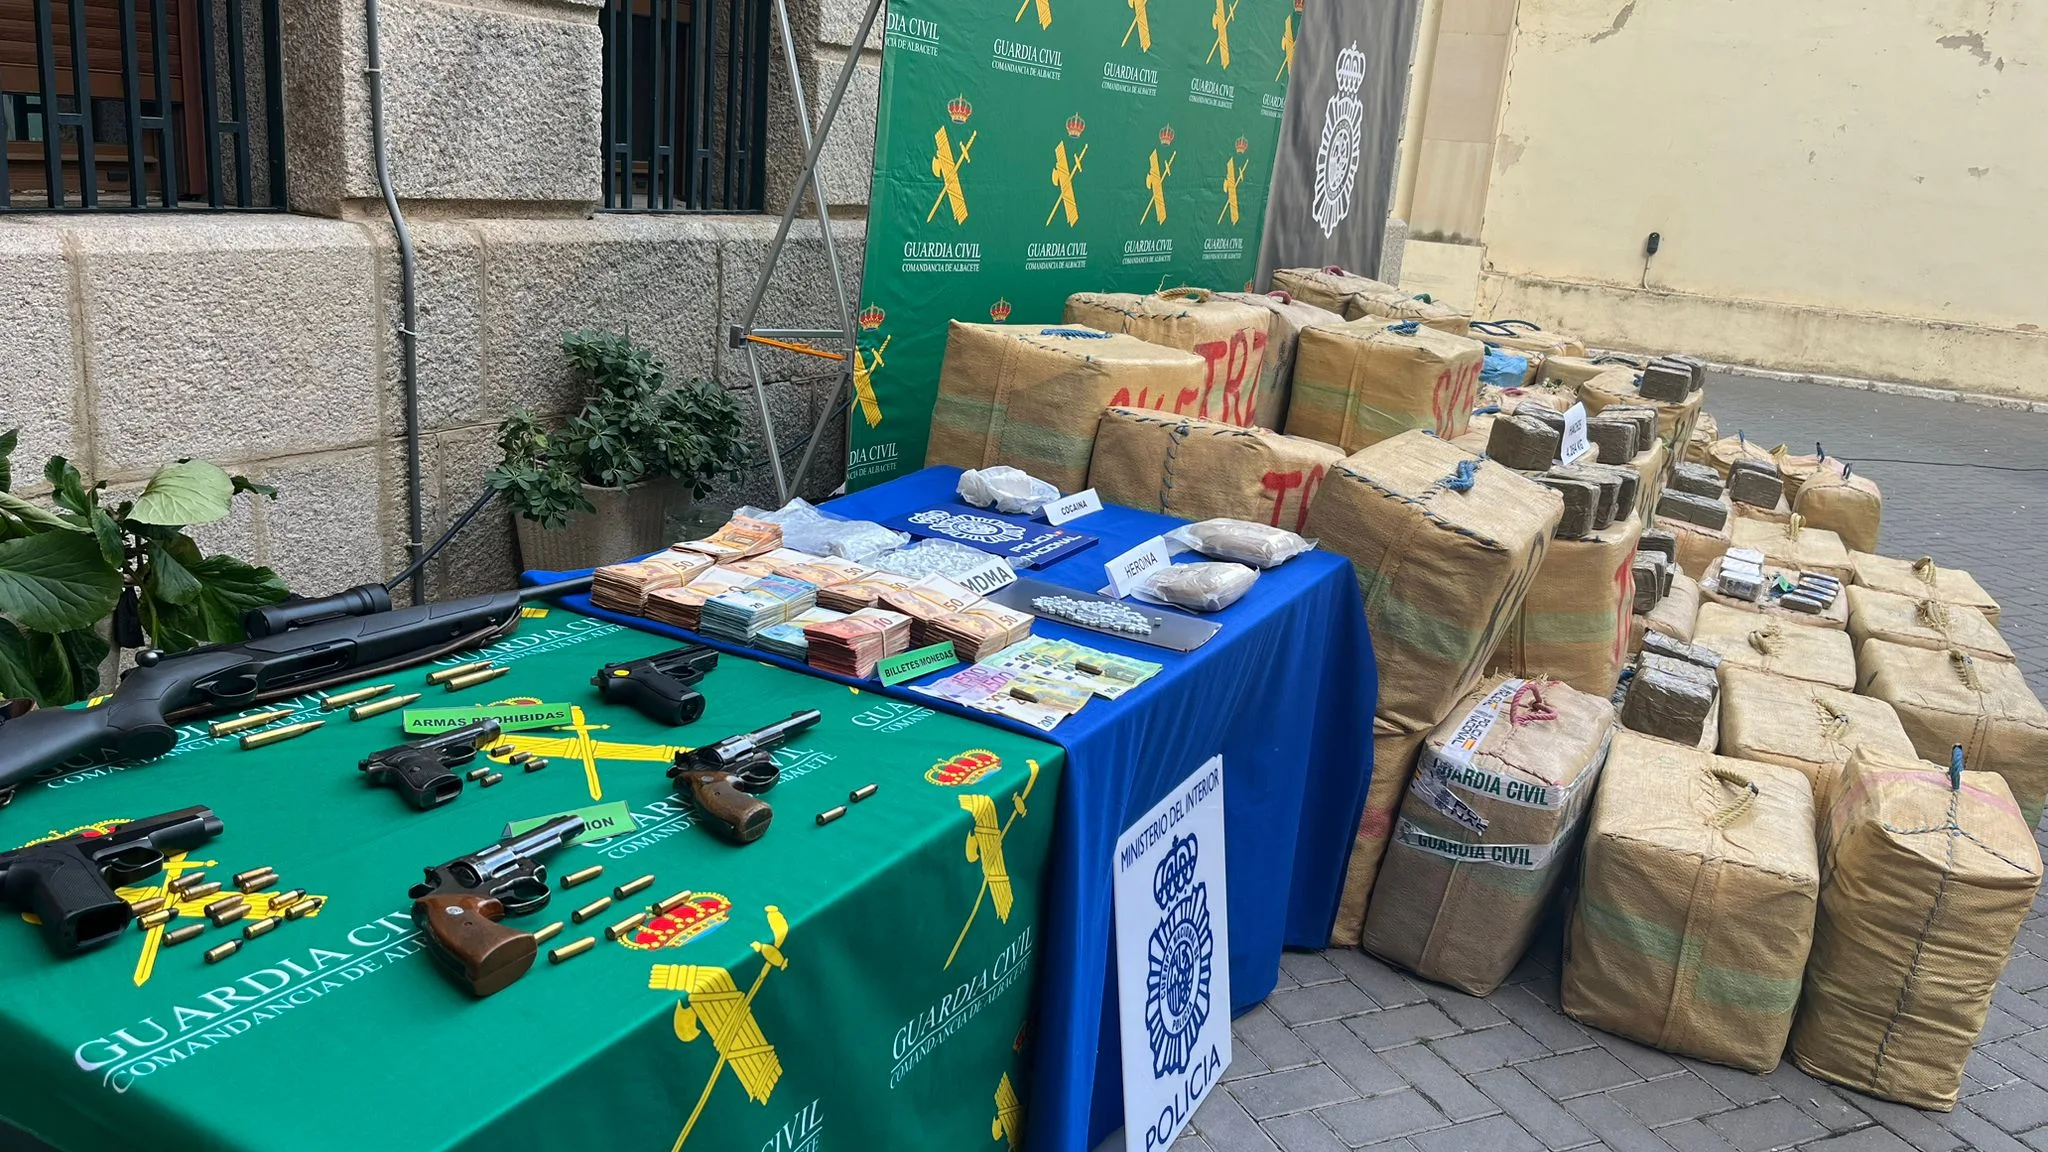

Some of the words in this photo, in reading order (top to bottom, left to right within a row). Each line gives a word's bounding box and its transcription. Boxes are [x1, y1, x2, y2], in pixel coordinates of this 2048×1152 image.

[909, 18, 940, 41] CIVIL
[898, 39, 907, 50] DE
[907, 42, 939, 57] ALBACETE
[994, 38, 1038, 63] GUARDIA
[1039, 48, 1063, 67] CIVIL
[992, 62, 1029, 76] COMANDANCIA
[1029, 68, 1037, 77] DE
[1037, 70, 1061, 81] ALBACETE
[1104, 62, 1139, 82] GUARDIA
[1139, 68, 1159, 84] CIVIL
[1190, 78, 1219, 94] GUARDIA
[1218, 83, 1235, 98] CIVIL
[904, 242, 953, 258] GUARDIA
[954, 243, 981, 258] CIVIL
[1028, 243, 1067, 258] GUARDIA
[1067, 242, 1088, 256] CIVIL
[1124, 240, 1155, 254] GUARDIA
[1156, 238, 1174, 251] CIVIL
[1204, 238, 1229, 250] GUARDIA
[1228, 238, 1244, 250] CIVIL
[902, 263, 945, 273] COMANDANCIA
[945, 264, 952, 272] DE
[952, 264, 980, 272] ALBACETE
[869, 442, 898, 460] CIVIL
[868, 462, 896, 474] ALBACETE
[1061, 500, 1088, 516] COCAINA
[672, 560, 695, 571] 50
[844, 567, 864, 576] 50
[1124, 552, 1158, 579] HEROINA
[960, 566, 1013, 595] MDMA
[943, 598, 964, 612] 50
[873, 616, 893, 628] 10
[998, 614, 1019, 626] 50
[412, 718, 466, 727] ARMAS
[1506, 780, 1549, 806] CIVIL
[1121, 814, 1168, 873] MINISTERIO
[1169, 800, 1184, 828] DEL
[1185, 768, 1220, 814] INTERIOR
[1418, 834, 1486, 859] GUARDIA
[1492, 846, 1534, 866] CIVIL
[1161, 945, 1173, 1000] CUERPO
[892, 969, 988, 1060] GUARDIA
[992, 926, 1033, 981] CIVIL
[73, 947, 354, 1072] GUARDIA
[1172, 1001, 1193, 1031] POLICIA
[112, 979, 344, 1094] COMANDANCIA
[340, 959, 383, 981] DE
[890, 1010, 968, 1090] COMANDANCIA
[969, 1001, 983, 1020] DE
[1145, 1044, 1221, 1152] POLICIA
[762, 1098, 824, 1152] CIVIL
